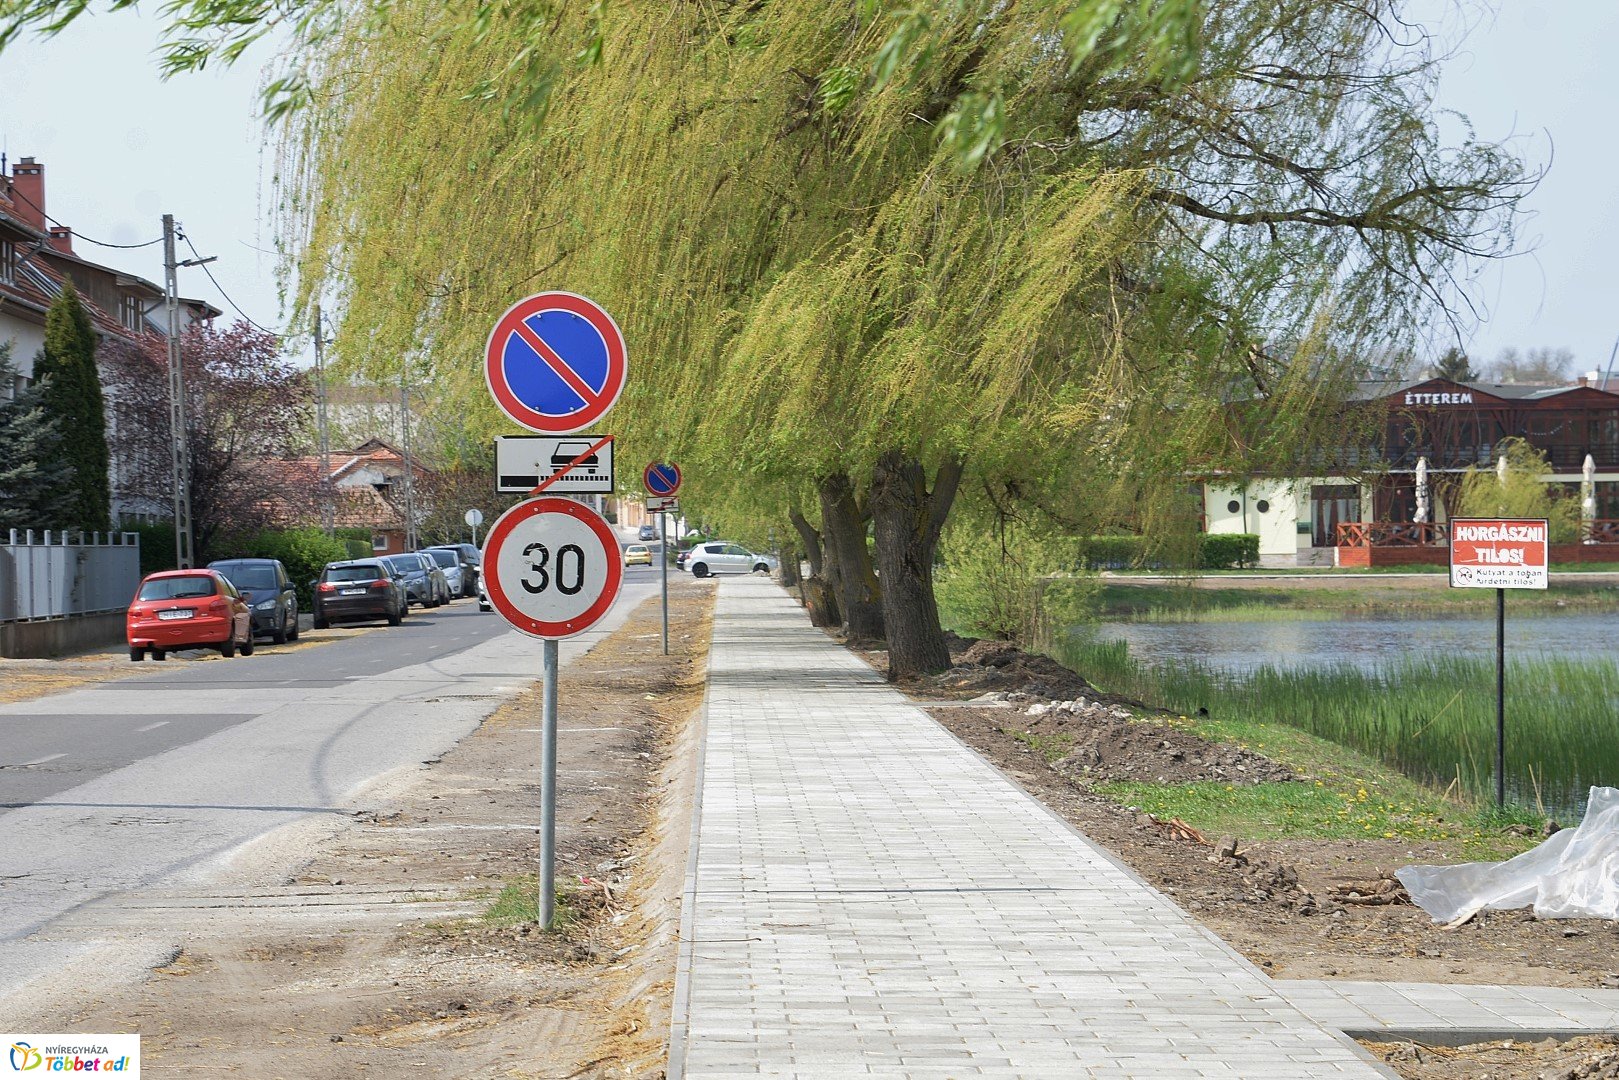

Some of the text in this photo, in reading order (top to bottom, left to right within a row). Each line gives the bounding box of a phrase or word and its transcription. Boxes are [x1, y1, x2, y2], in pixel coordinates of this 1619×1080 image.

[1404, 391, 1473, 405] ÉTTEREM
[1456, 523, 1544, 542] HORGÁSZNI
[1476, 547, 1525, 564] TILOS!
[520, 542, 585, 595] 30
